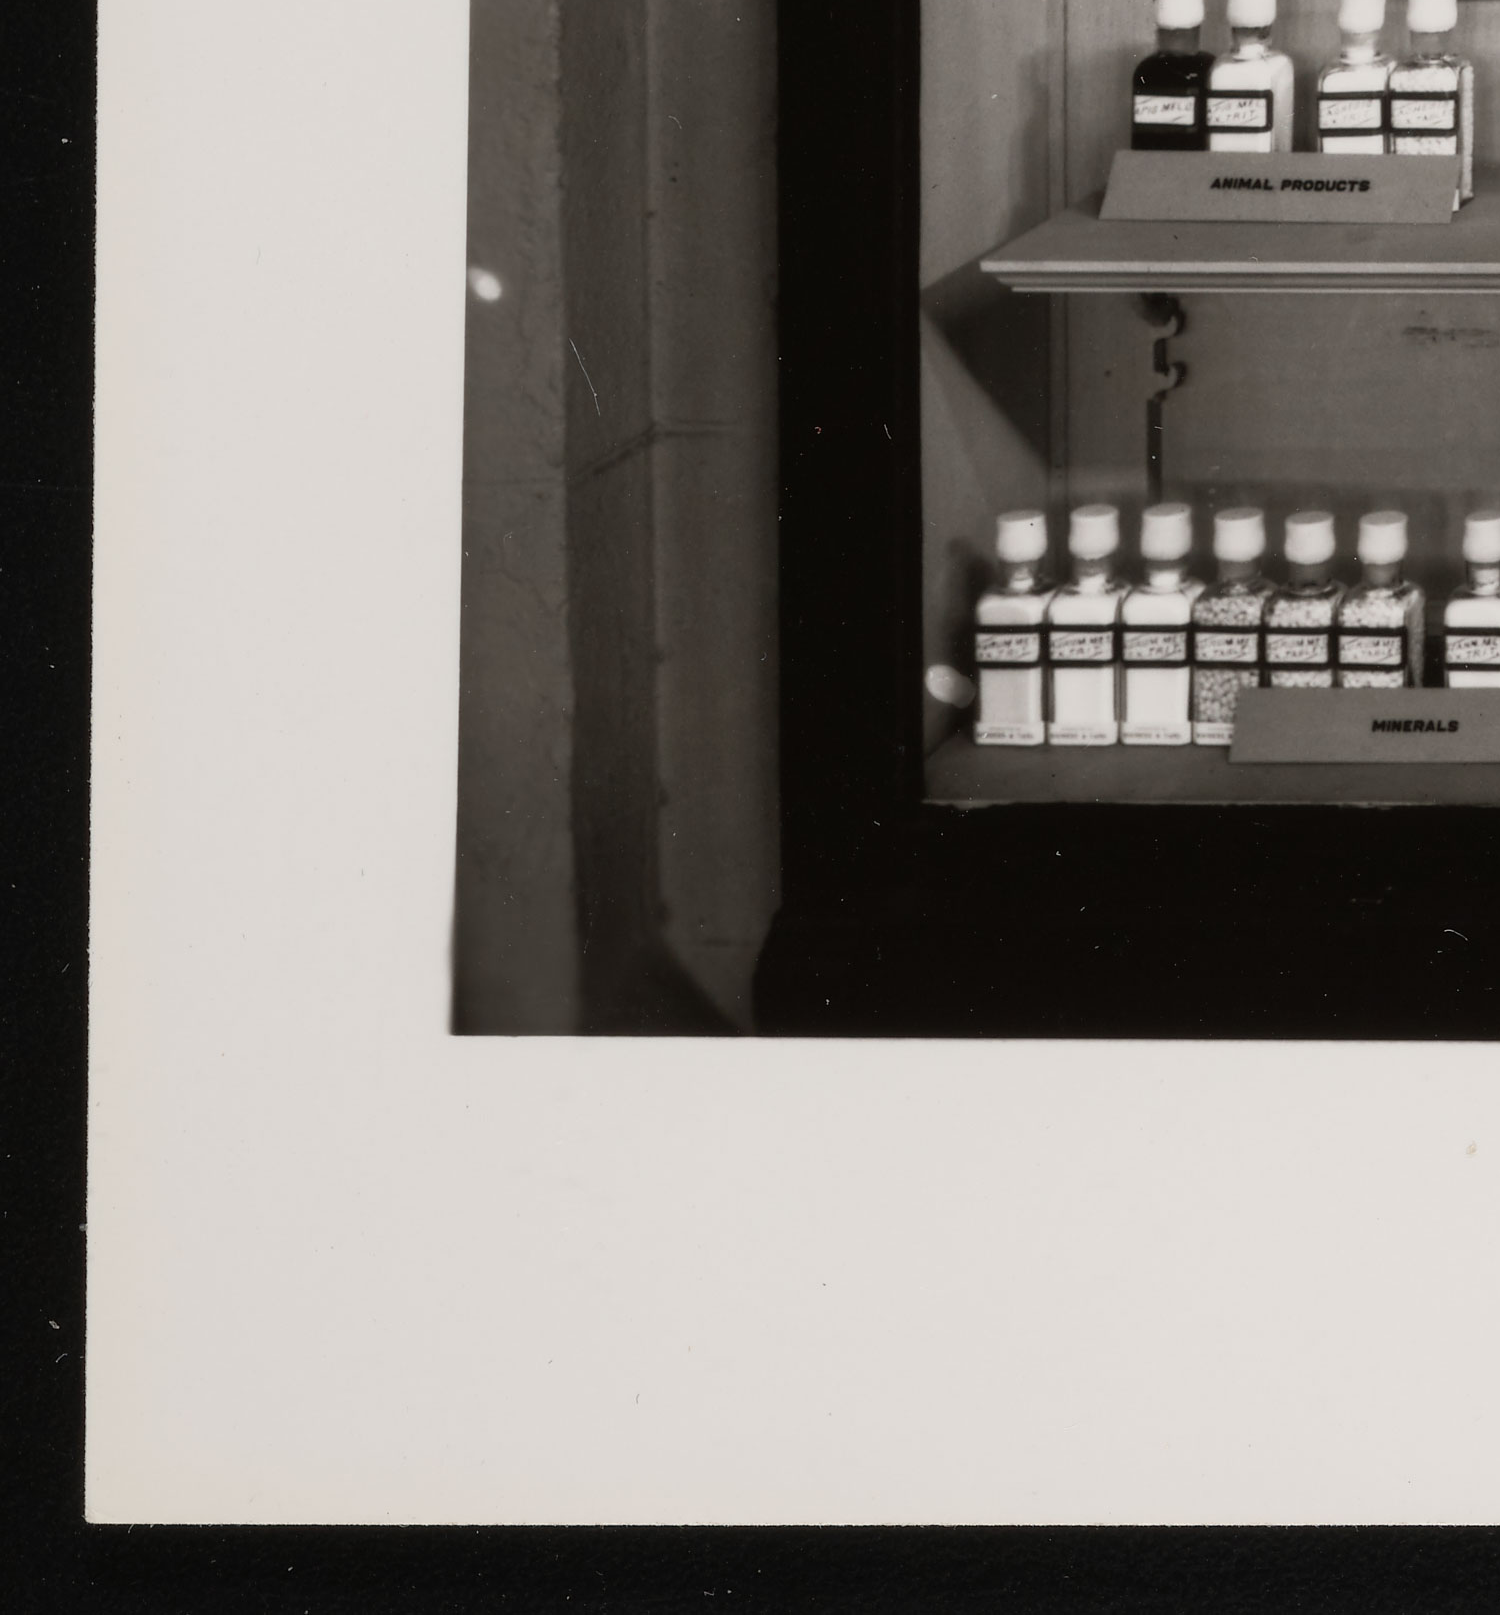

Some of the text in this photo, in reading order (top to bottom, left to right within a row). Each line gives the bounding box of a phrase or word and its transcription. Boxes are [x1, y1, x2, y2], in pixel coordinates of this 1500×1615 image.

[1210, 177, 1371, 193] ANIMAL PRODUCTS
[1371, 719, 1460, 734] MINERALS
